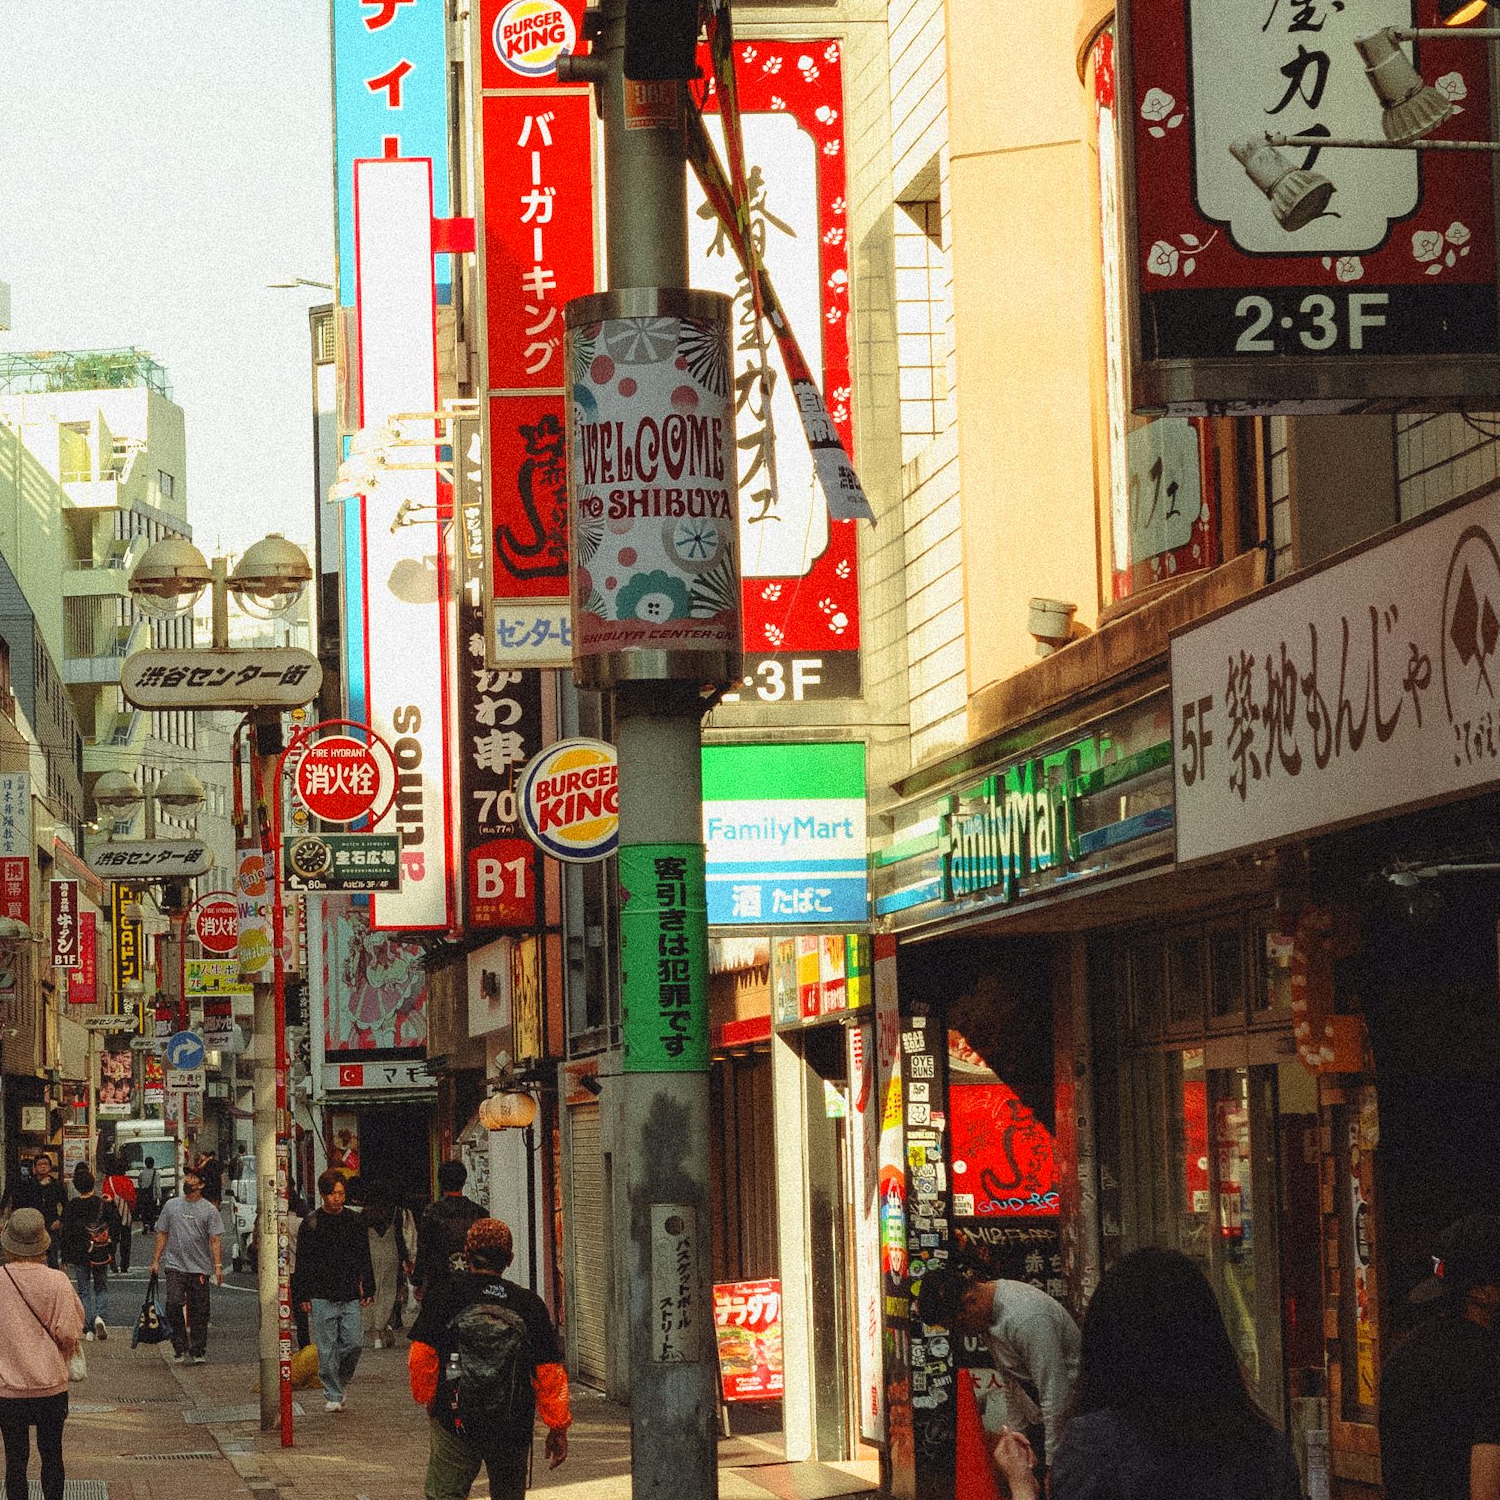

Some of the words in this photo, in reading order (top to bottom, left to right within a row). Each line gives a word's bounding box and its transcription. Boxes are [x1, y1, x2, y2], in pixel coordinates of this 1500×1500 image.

[503, 10, 562, 41] BURGER
[506, 23, 566, 60] KING
[517, 110, 557, 377] バーガーキング
[580, 417, 725, 487] WELCOME
[607, 488, 733, 520] SHIBUYA
[582, 629, 646, 644] SHIBUYA
[133, 663, 313, 688] 渋谷センター街
[1182, 694, 1213, 787] 5F
[1224, 603, 1433, 803] 築地もんじゃ
[311, 748, 329, 758] FIRE
[330, 748, 367, 758] HYDRANT
[305, 762, 375, 796] 消火栓
[707, 815, 853, 847] FamilyMart
[938, 748, 1083, 902] FamilyMart
[94, 847, 203, 867] 渋谷センター街
[335, 850, 396, 866] 宝石広場
[308, 879, 327, 890] 80m
[476, 856, 527, 900] B1
[731, 884, 763, 918] 酒
[772, 884, 834, 915] たばこ
[54, 955, 77, 965] B1F
[653, 856, 692, 1059] 客引きは犯罪です
[911, 1056, 934, 1067] OYE
[912, 1066, 935, 1077] RUNS
